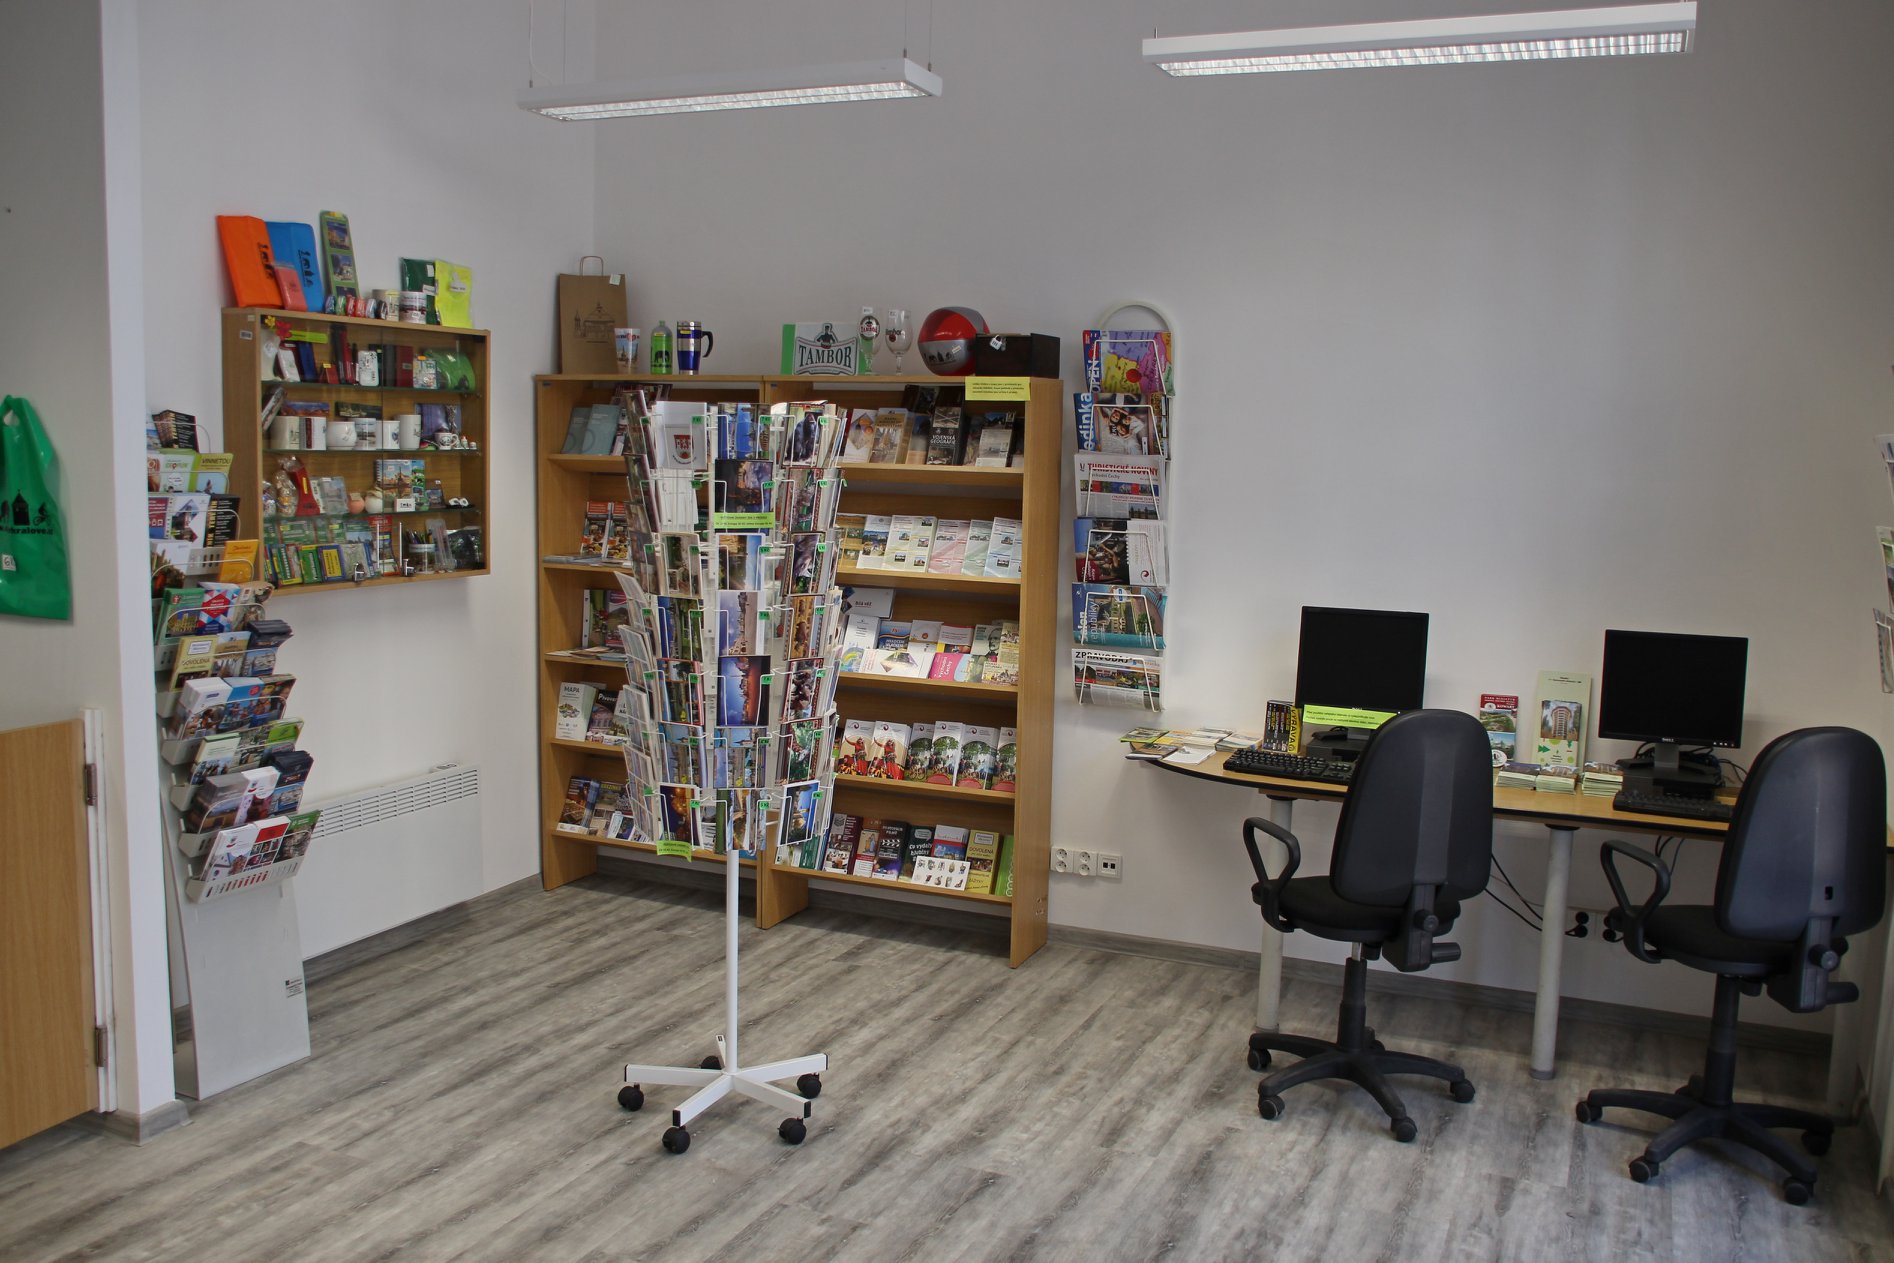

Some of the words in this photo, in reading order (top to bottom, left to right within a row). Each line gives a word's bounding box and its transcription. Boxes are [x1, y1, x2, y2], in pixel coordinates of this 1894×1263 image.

[798, 345, 852, 369] TAMBOR
[1087, 359, 1102, 393] OPEN
[1088, 600, 1099, 644] republiky
[1075, 651, 1129, 664] ZPRAVODAJ
[564, 686, 581, 694] MAPA
[969, 846, 994, 854] DOVOLENÁ
